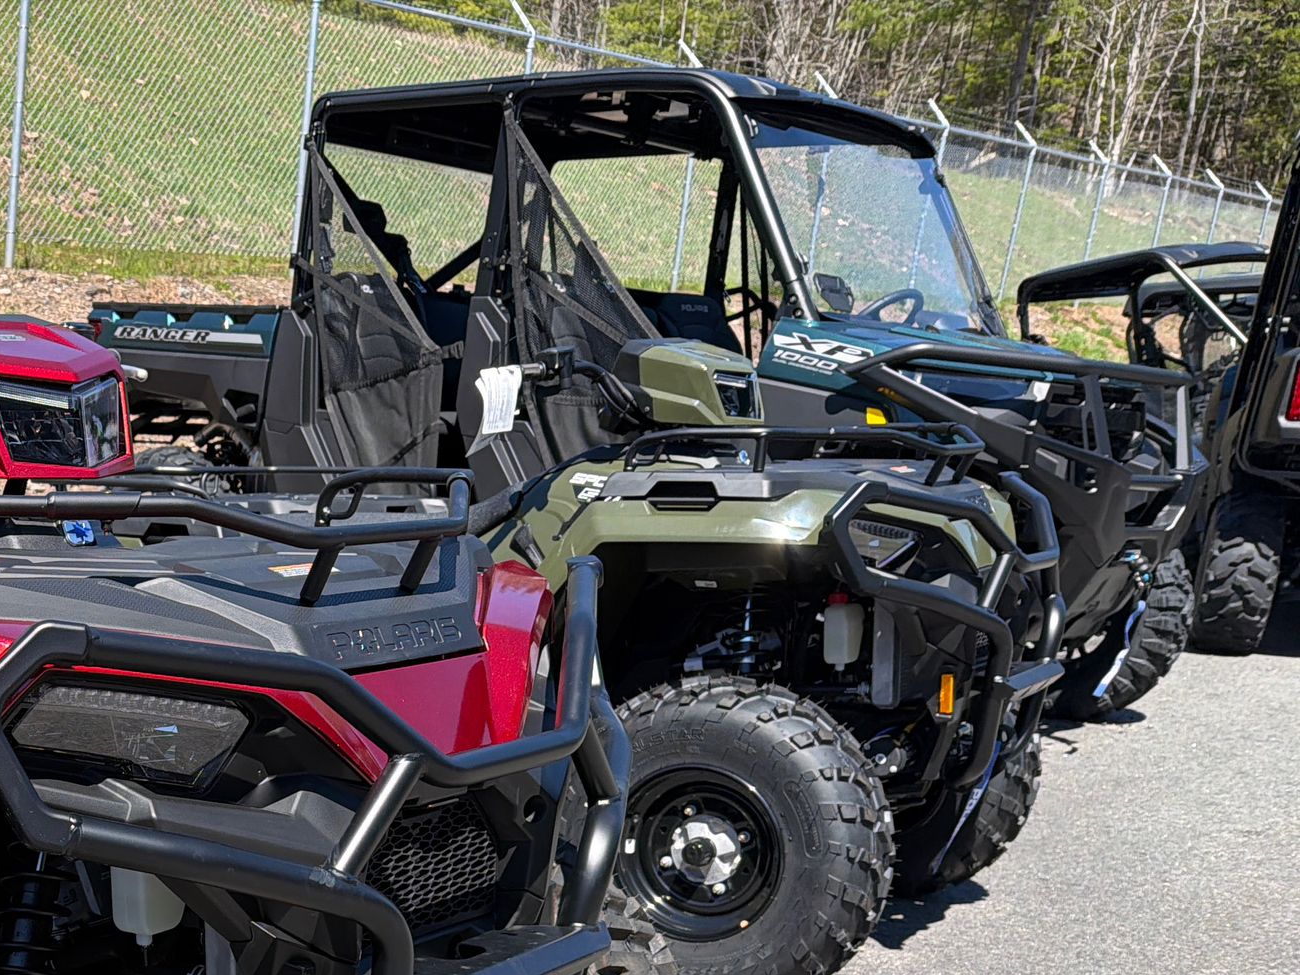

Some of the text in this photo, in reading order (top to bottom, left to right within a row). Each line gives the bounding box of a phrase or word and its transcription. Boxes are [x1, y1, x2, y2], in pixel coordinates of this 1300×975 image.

[117, 326, 211, 344] RANGER
[774, 332, 874, 364] XP
[773, 349, 839, 371] 1000
[326, 616, 462, 662] POLARIS
